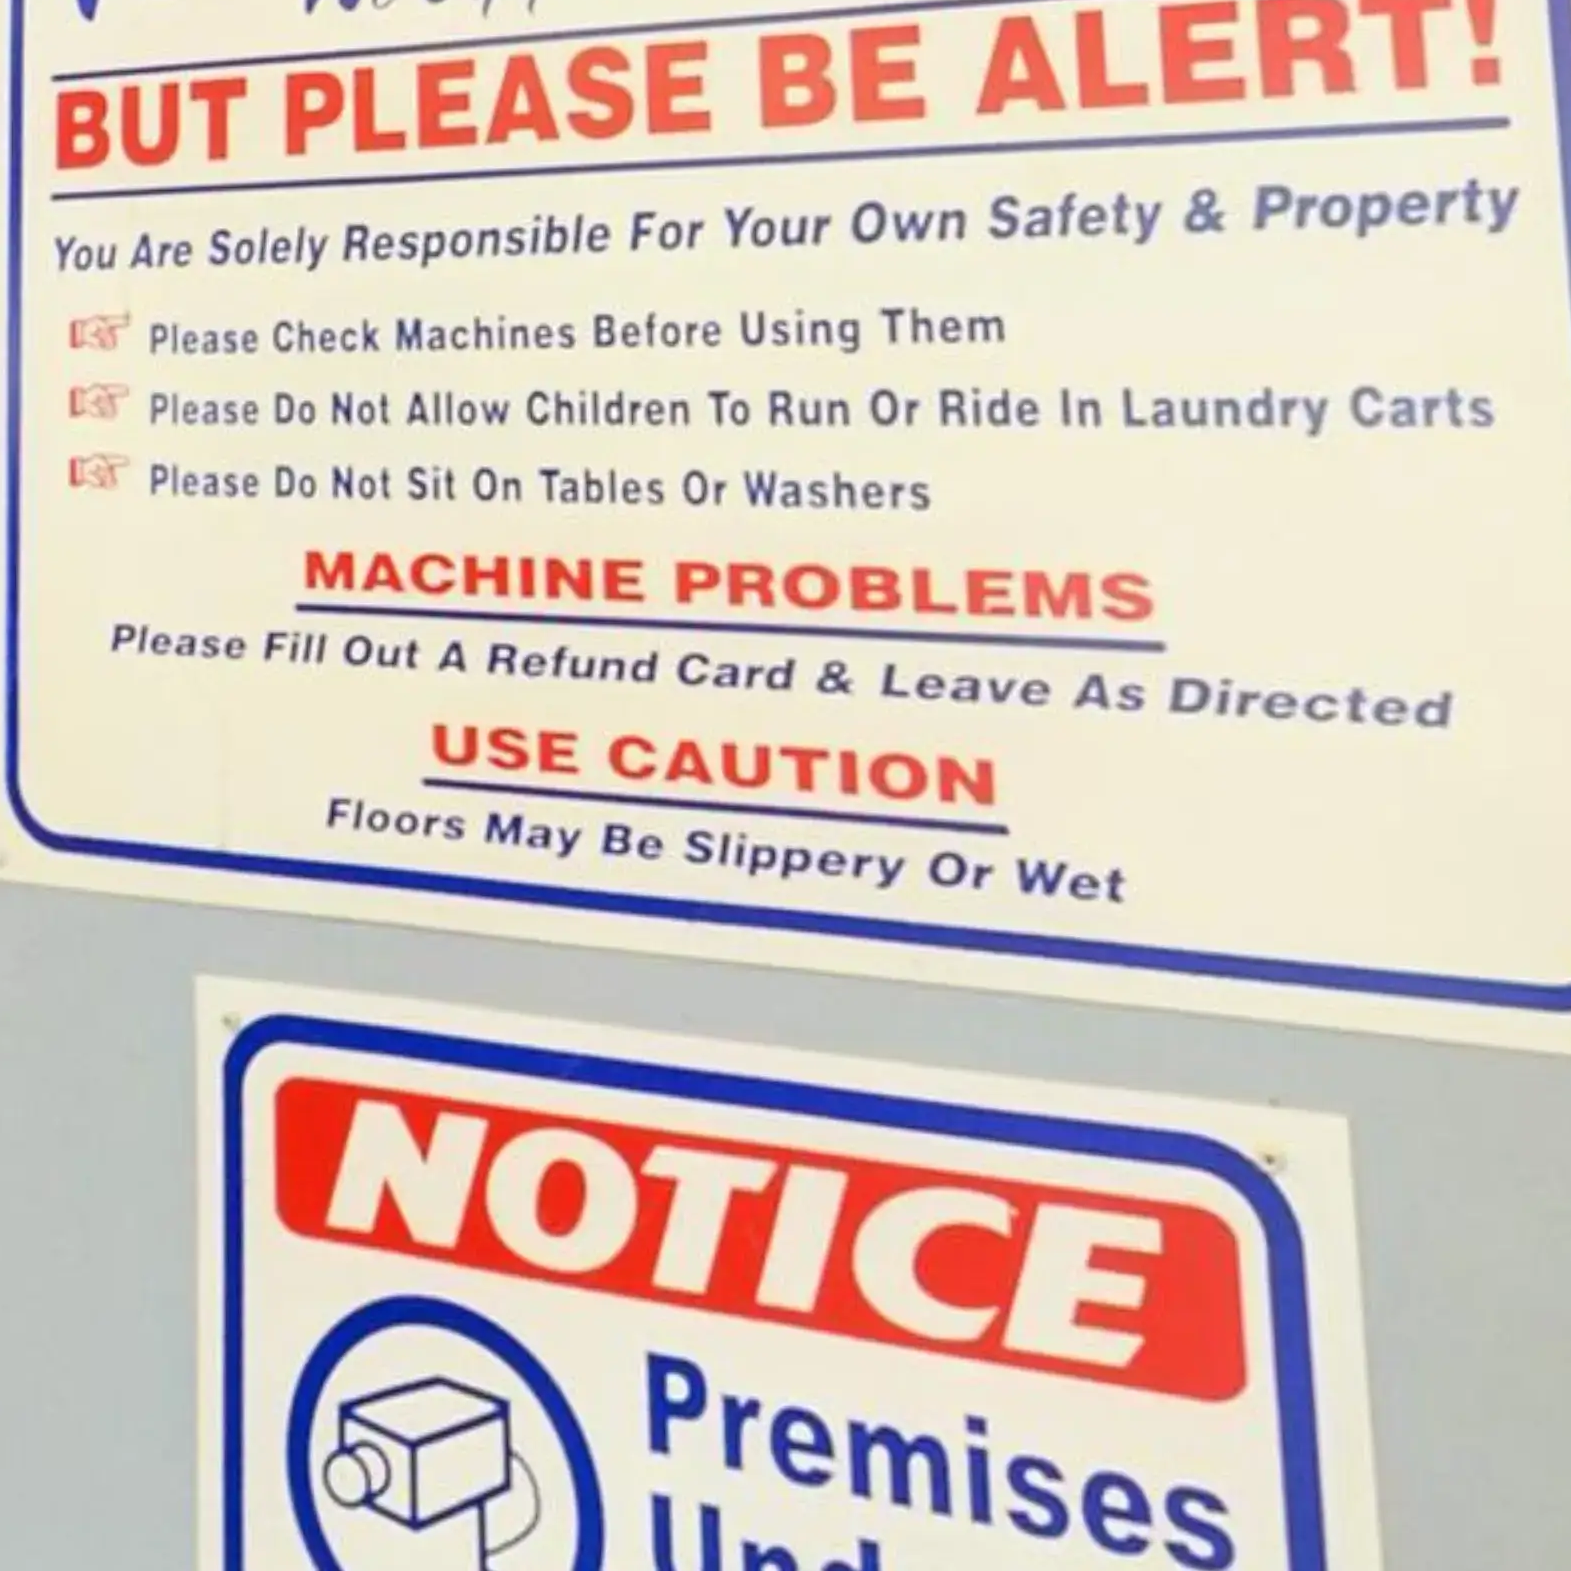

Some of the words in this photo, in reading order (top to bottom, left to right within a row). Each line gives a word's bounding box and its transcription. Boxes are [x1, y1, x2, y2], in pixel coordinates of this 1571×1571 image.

[56, 76, 248, 170] BUT
[285, 40, 711, 156] PLEASE
[759, 24, 926, 129] BE
[55, 236, 117, 271] You
[130, 233, 193, 269] Are
[209, 226, 328, 272] Solely
[343, 214, 611, 268] Responsible
[630, 211, 705, 251] For
[724, 206, 832, 248] Your
[851, 200, 966, 244] Own
[988, 192, 1162, 245] Safety
[1183, 187, 1225, 234] &
[1253, 178, 1520, 239] Property
[150, 322, 259, 355] Please
[272, 319, 380, 353] Check
[395, 315, 576, 351] Machines
[593, 312, 722, 348] Before
[740, 308, 860, 354] Using
[879, 307, 1005, 344] Them
[150, 392, 259, 426] Please
[274, 392, 316, 425] Do
[332, 392, 389, 426] Not
[406, 391, 510, 426] Allow
[526, 390, 690, 426] Children
[707, 390, 750, 426] To
[769, 390, 850, 426] Run
[869, 388, 920, 427] Or
[939, 387, 1040, 427] Ride
[1061, 388, 1102, 427] In
[1122, 386, 1329, 438] Laundry
[1349, 385, 1495, 428] Carts
[150, 463, 260, 498] Please
[275, 465, 317, 499] Do
[332, 466, 390, 500] Not
[408, 466, 455, 501] Sit
[472, 466, 522, 502] On
[538, 468, 665, 505] Tables
[682, 469, 727, 506] Or
[743, 470, 931, 511] Washers
[305, 550, 645, 602] MACHINE
[675, 561, 1153, 621] PROBLEMS
[111, 623, 247, 660] Please
[264, 631, 327, 663] Fill
[343, 635, 418, 669] Out
[438, 641, 466, 672] A
[487, 643, 659, 682] Refund
[677, 653, 796, 690] Card
[816, 660, 851, 694] &
[881, 663, 1050, 706] Leave
[1074, 673, 1145, 711] As
[1168, 677, 1453, 728] Directed
[433, 724, 579, 775] USE
[608, 735, 995, 805] CAUTION
[327, 798, 464, 838] Floors
[485, 813, 581, 858] May
[602, 823, 663, 859] Be
[685, 830, 904, 889] Slippery
[929, 851, 993, 889] Or
[1017, 858, 1124, 903] Wet
[325, 1098, 1164, 1369] NOTICE
[646, 1352, 1235, 1571] Premises
